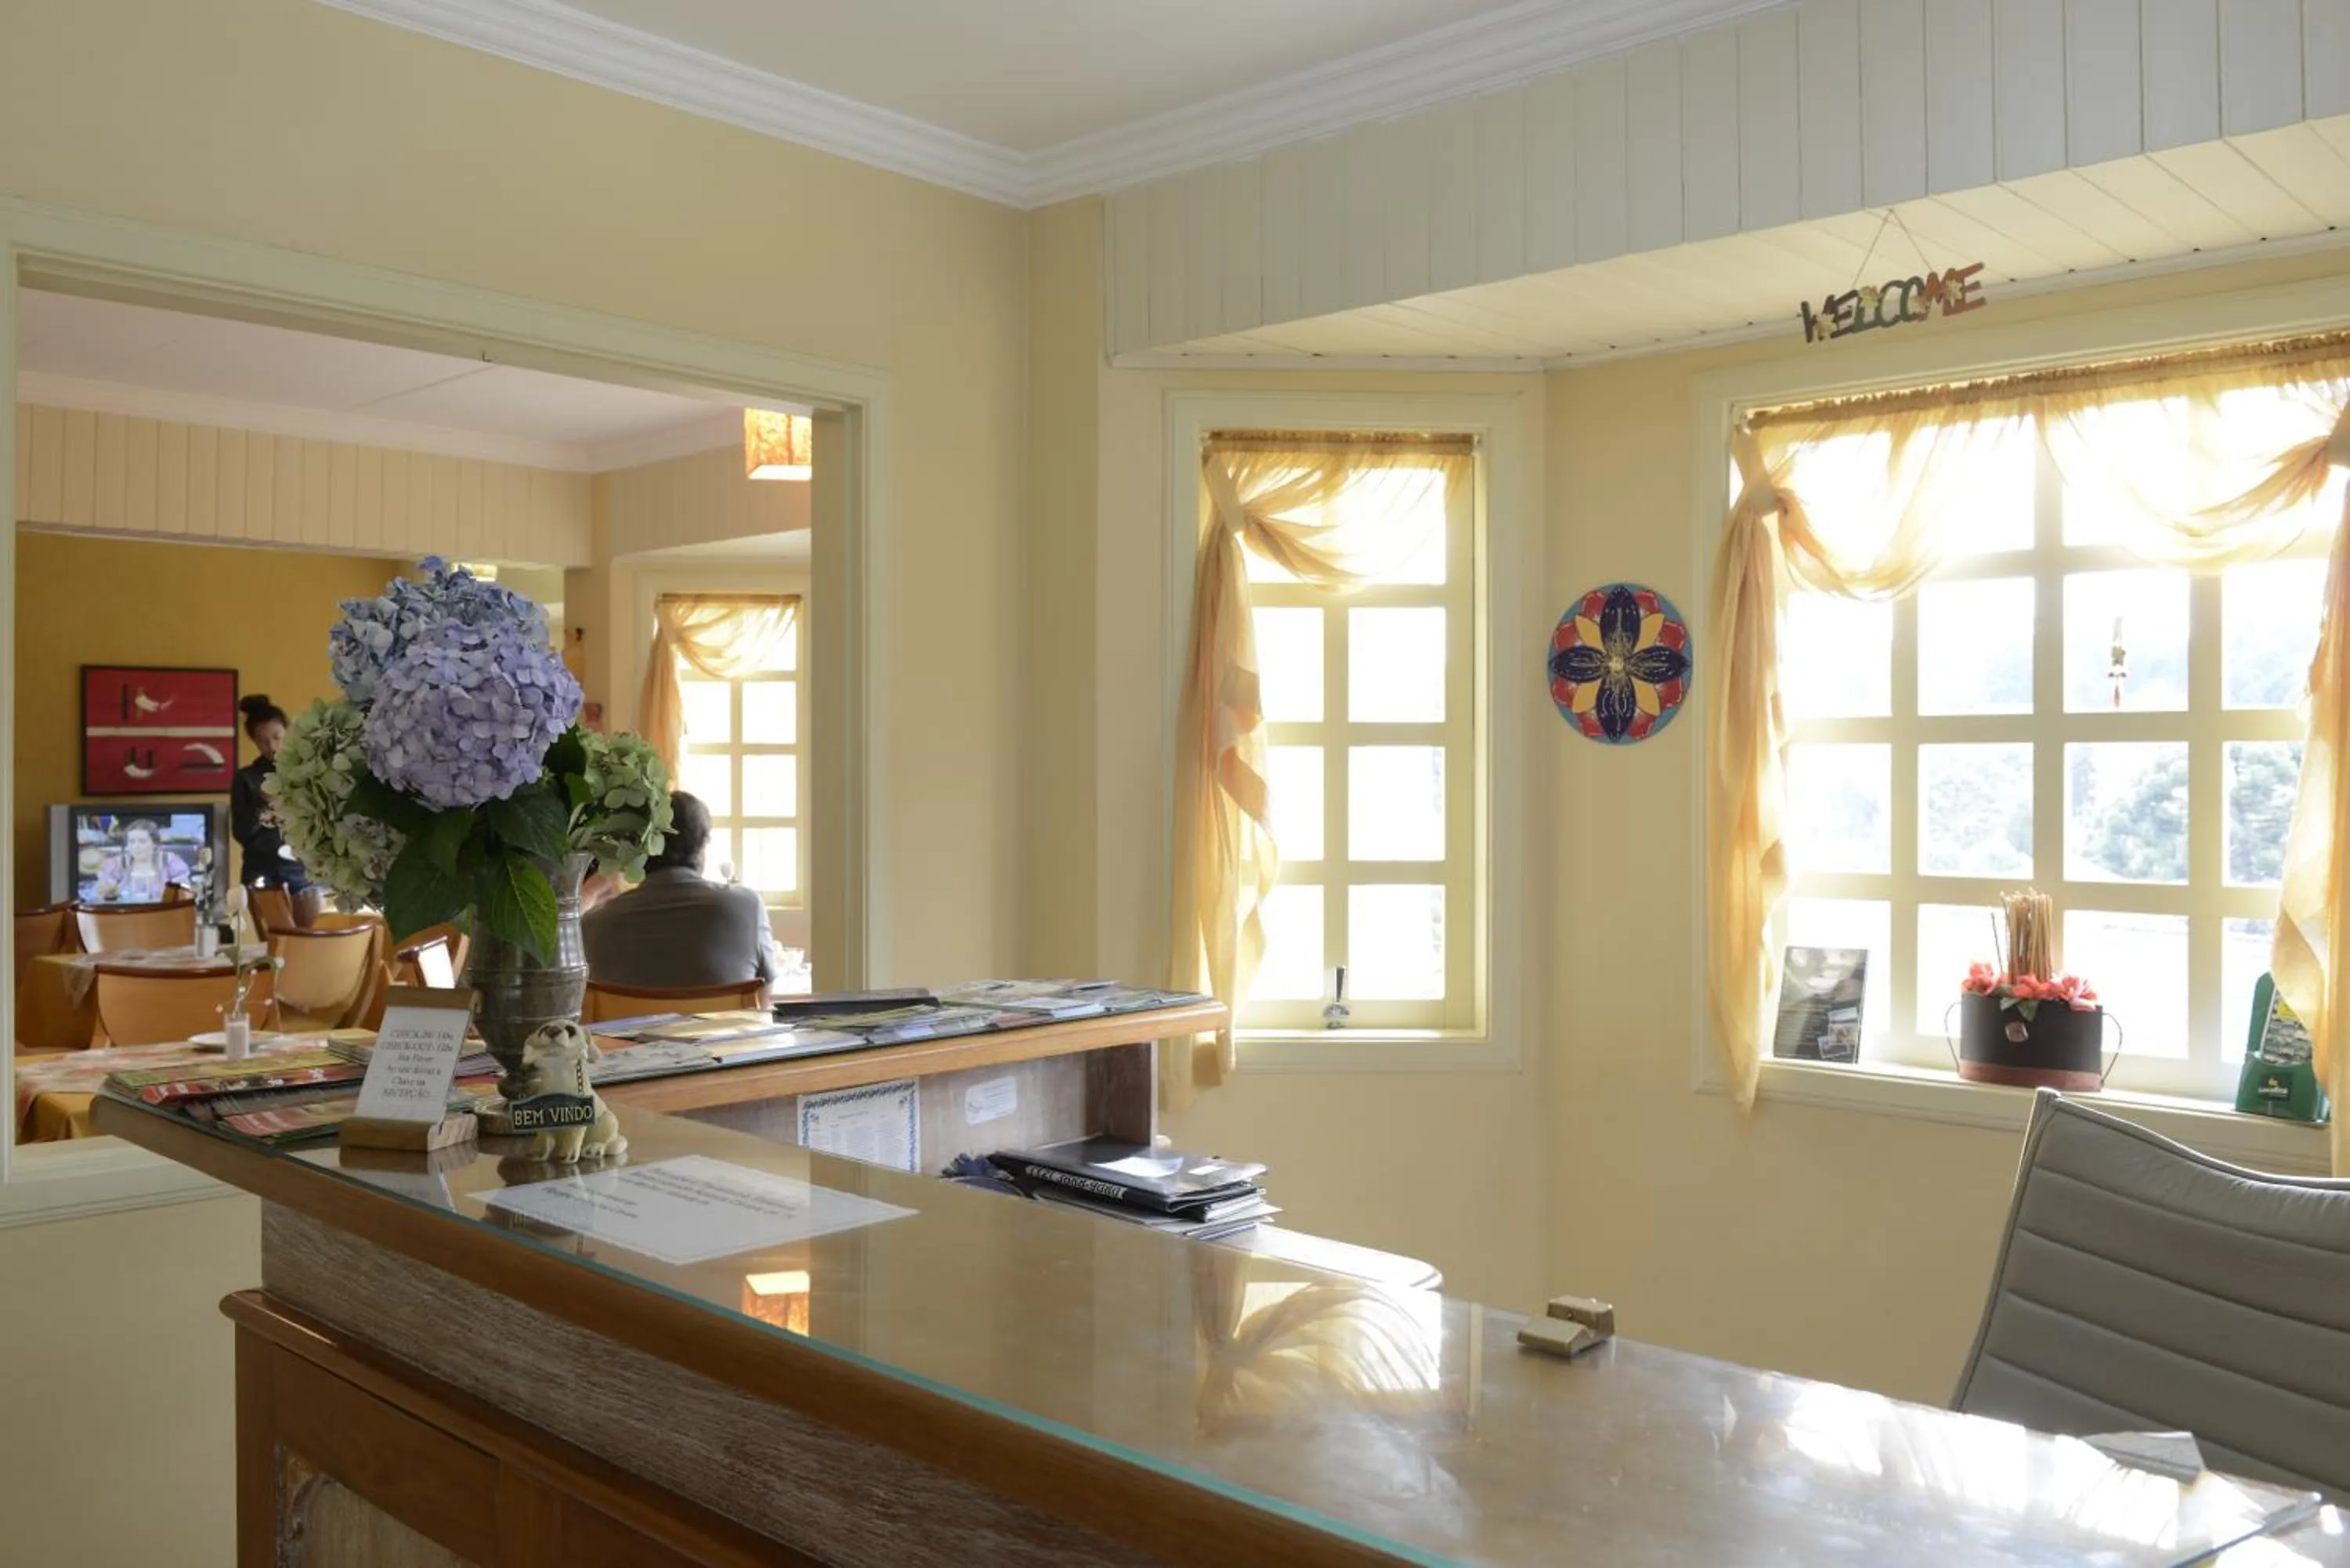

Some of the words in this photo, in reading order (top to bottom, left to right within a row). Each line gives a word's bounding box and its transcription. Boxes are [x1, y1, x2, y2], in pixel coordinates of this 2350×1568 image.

[1800, 262, 1987, 343] WELCOME
[515, 1108, 544, 1125] BEM
[548, 1105, 593, 1122] VINDO
